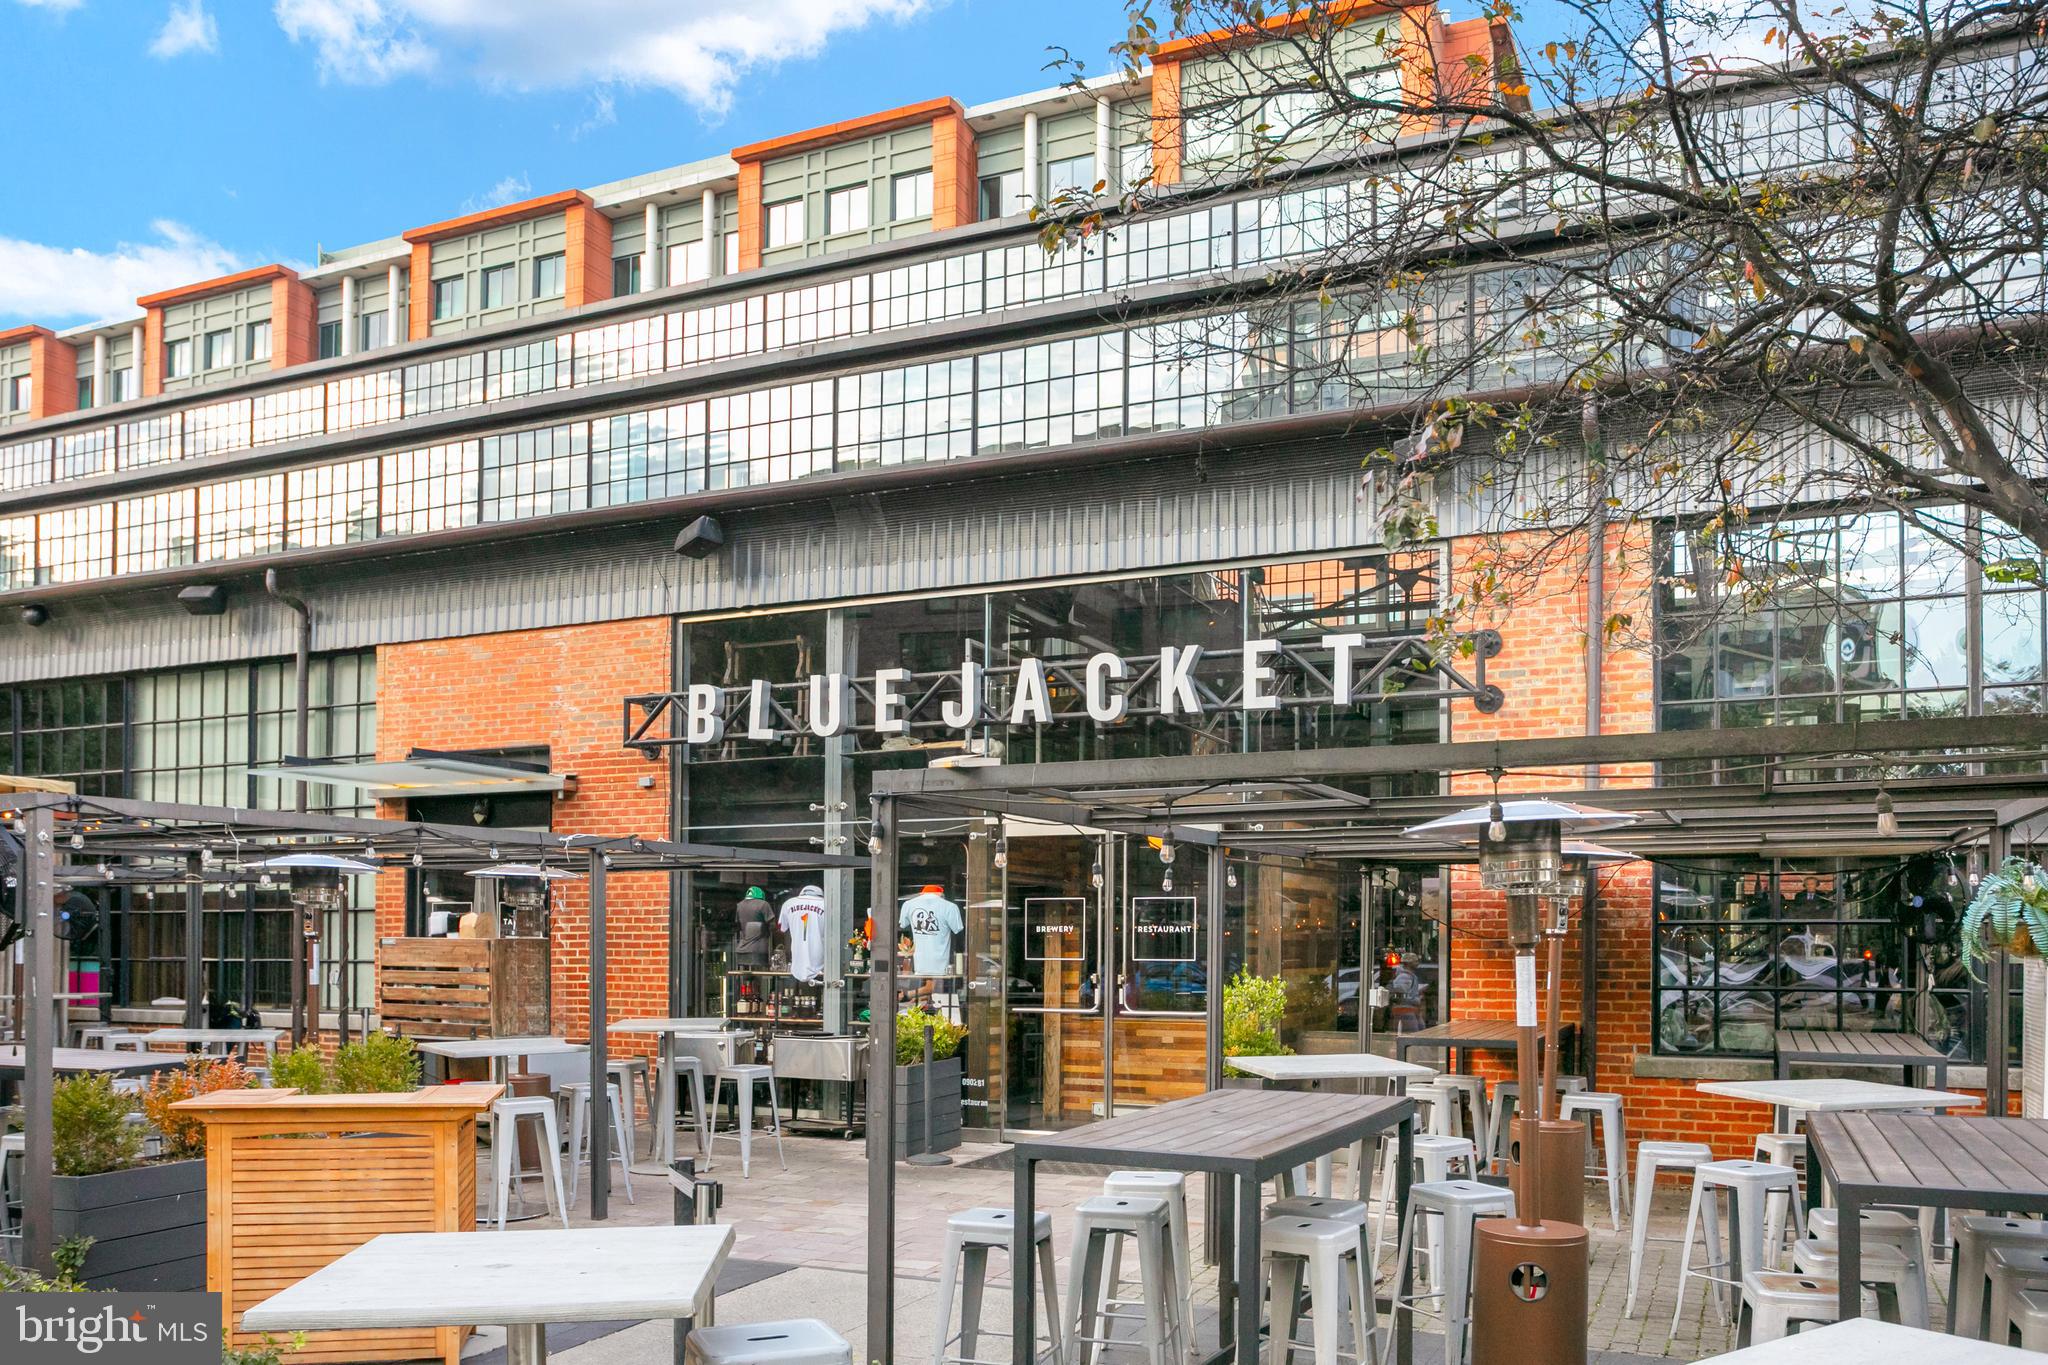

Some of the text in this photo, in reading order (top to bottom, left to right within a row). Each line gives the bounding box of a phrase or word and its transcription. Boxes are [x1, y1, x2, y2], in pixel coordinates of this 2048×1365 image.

[687, 634, 1366, 744] BLUEJACKET
[801, 912, 809, 941] 1
[1035, 925, 1074, 933] BREWERY
[1137, 925, 1192, 933] RESTAURANT
